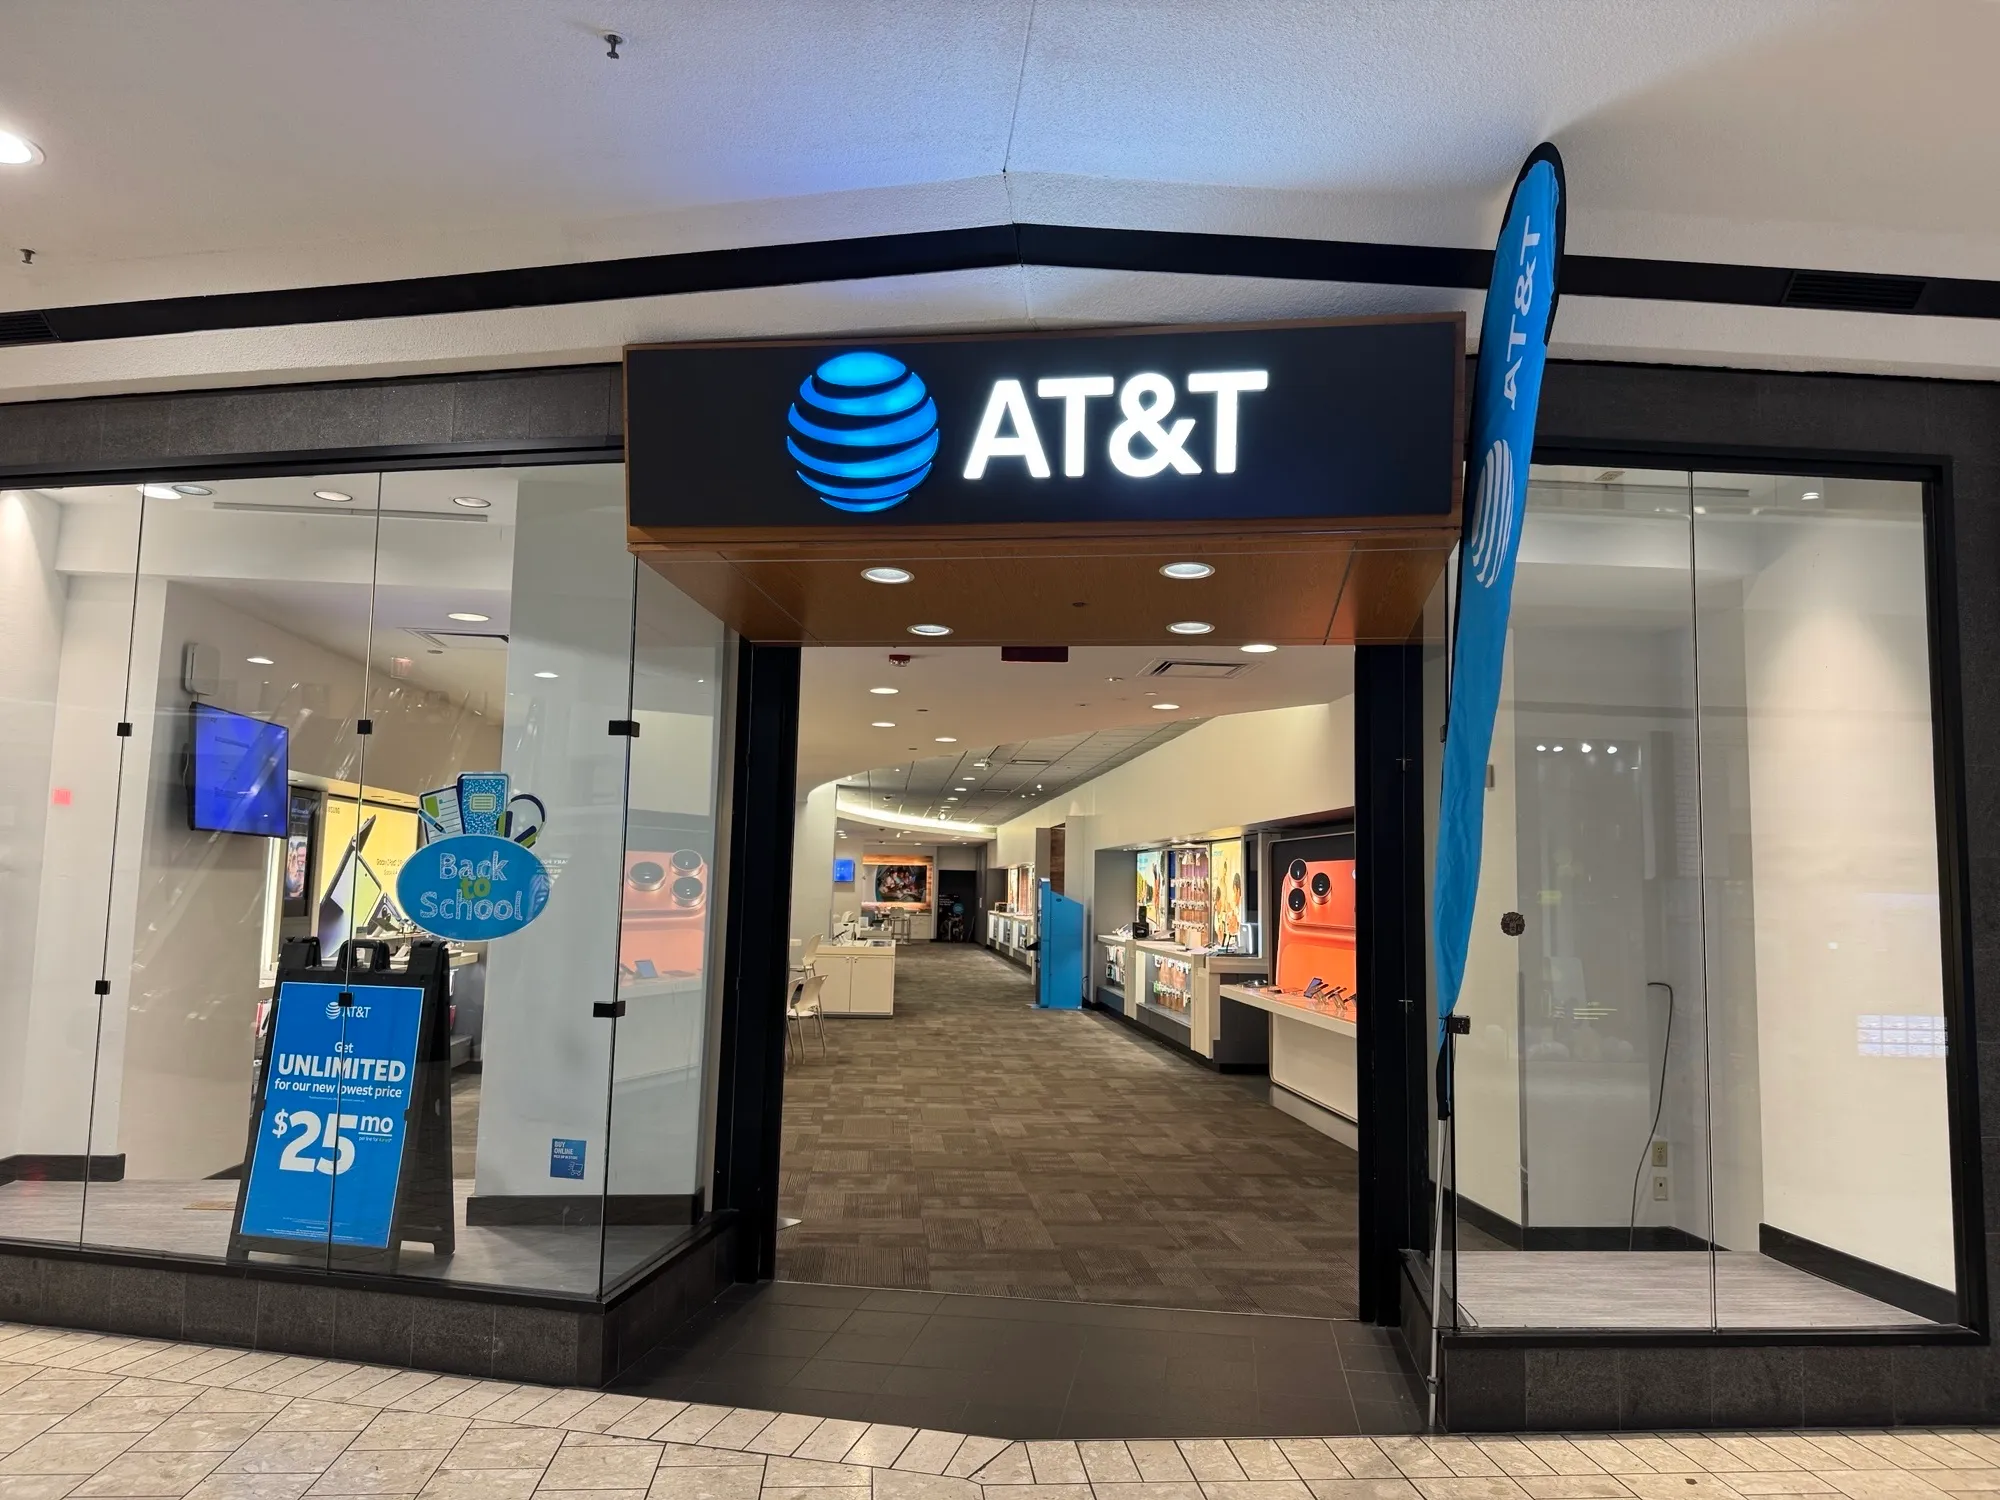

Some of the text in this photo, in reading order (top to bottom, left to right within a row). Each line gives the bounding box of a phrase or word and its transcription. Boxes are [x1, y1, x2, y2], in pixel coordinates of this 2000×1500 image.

[1503, 215, 1540, 410] AT&T
[963, 370, 1269, 480] AT&T
[439, 850, 509, 881] Back
[459, 876, 491, 899] to
[419, 889, 523, 921] School
[334, 1041, 354, 1054] Get
[278, 1053, 406, 1082] UNLIMITED
[274, 1078, 291, 1090] for
[292, 1081, 311, 1091] our
[312, 1083, 336, 1094] new
[359, 1115, 394, 1133] mo
